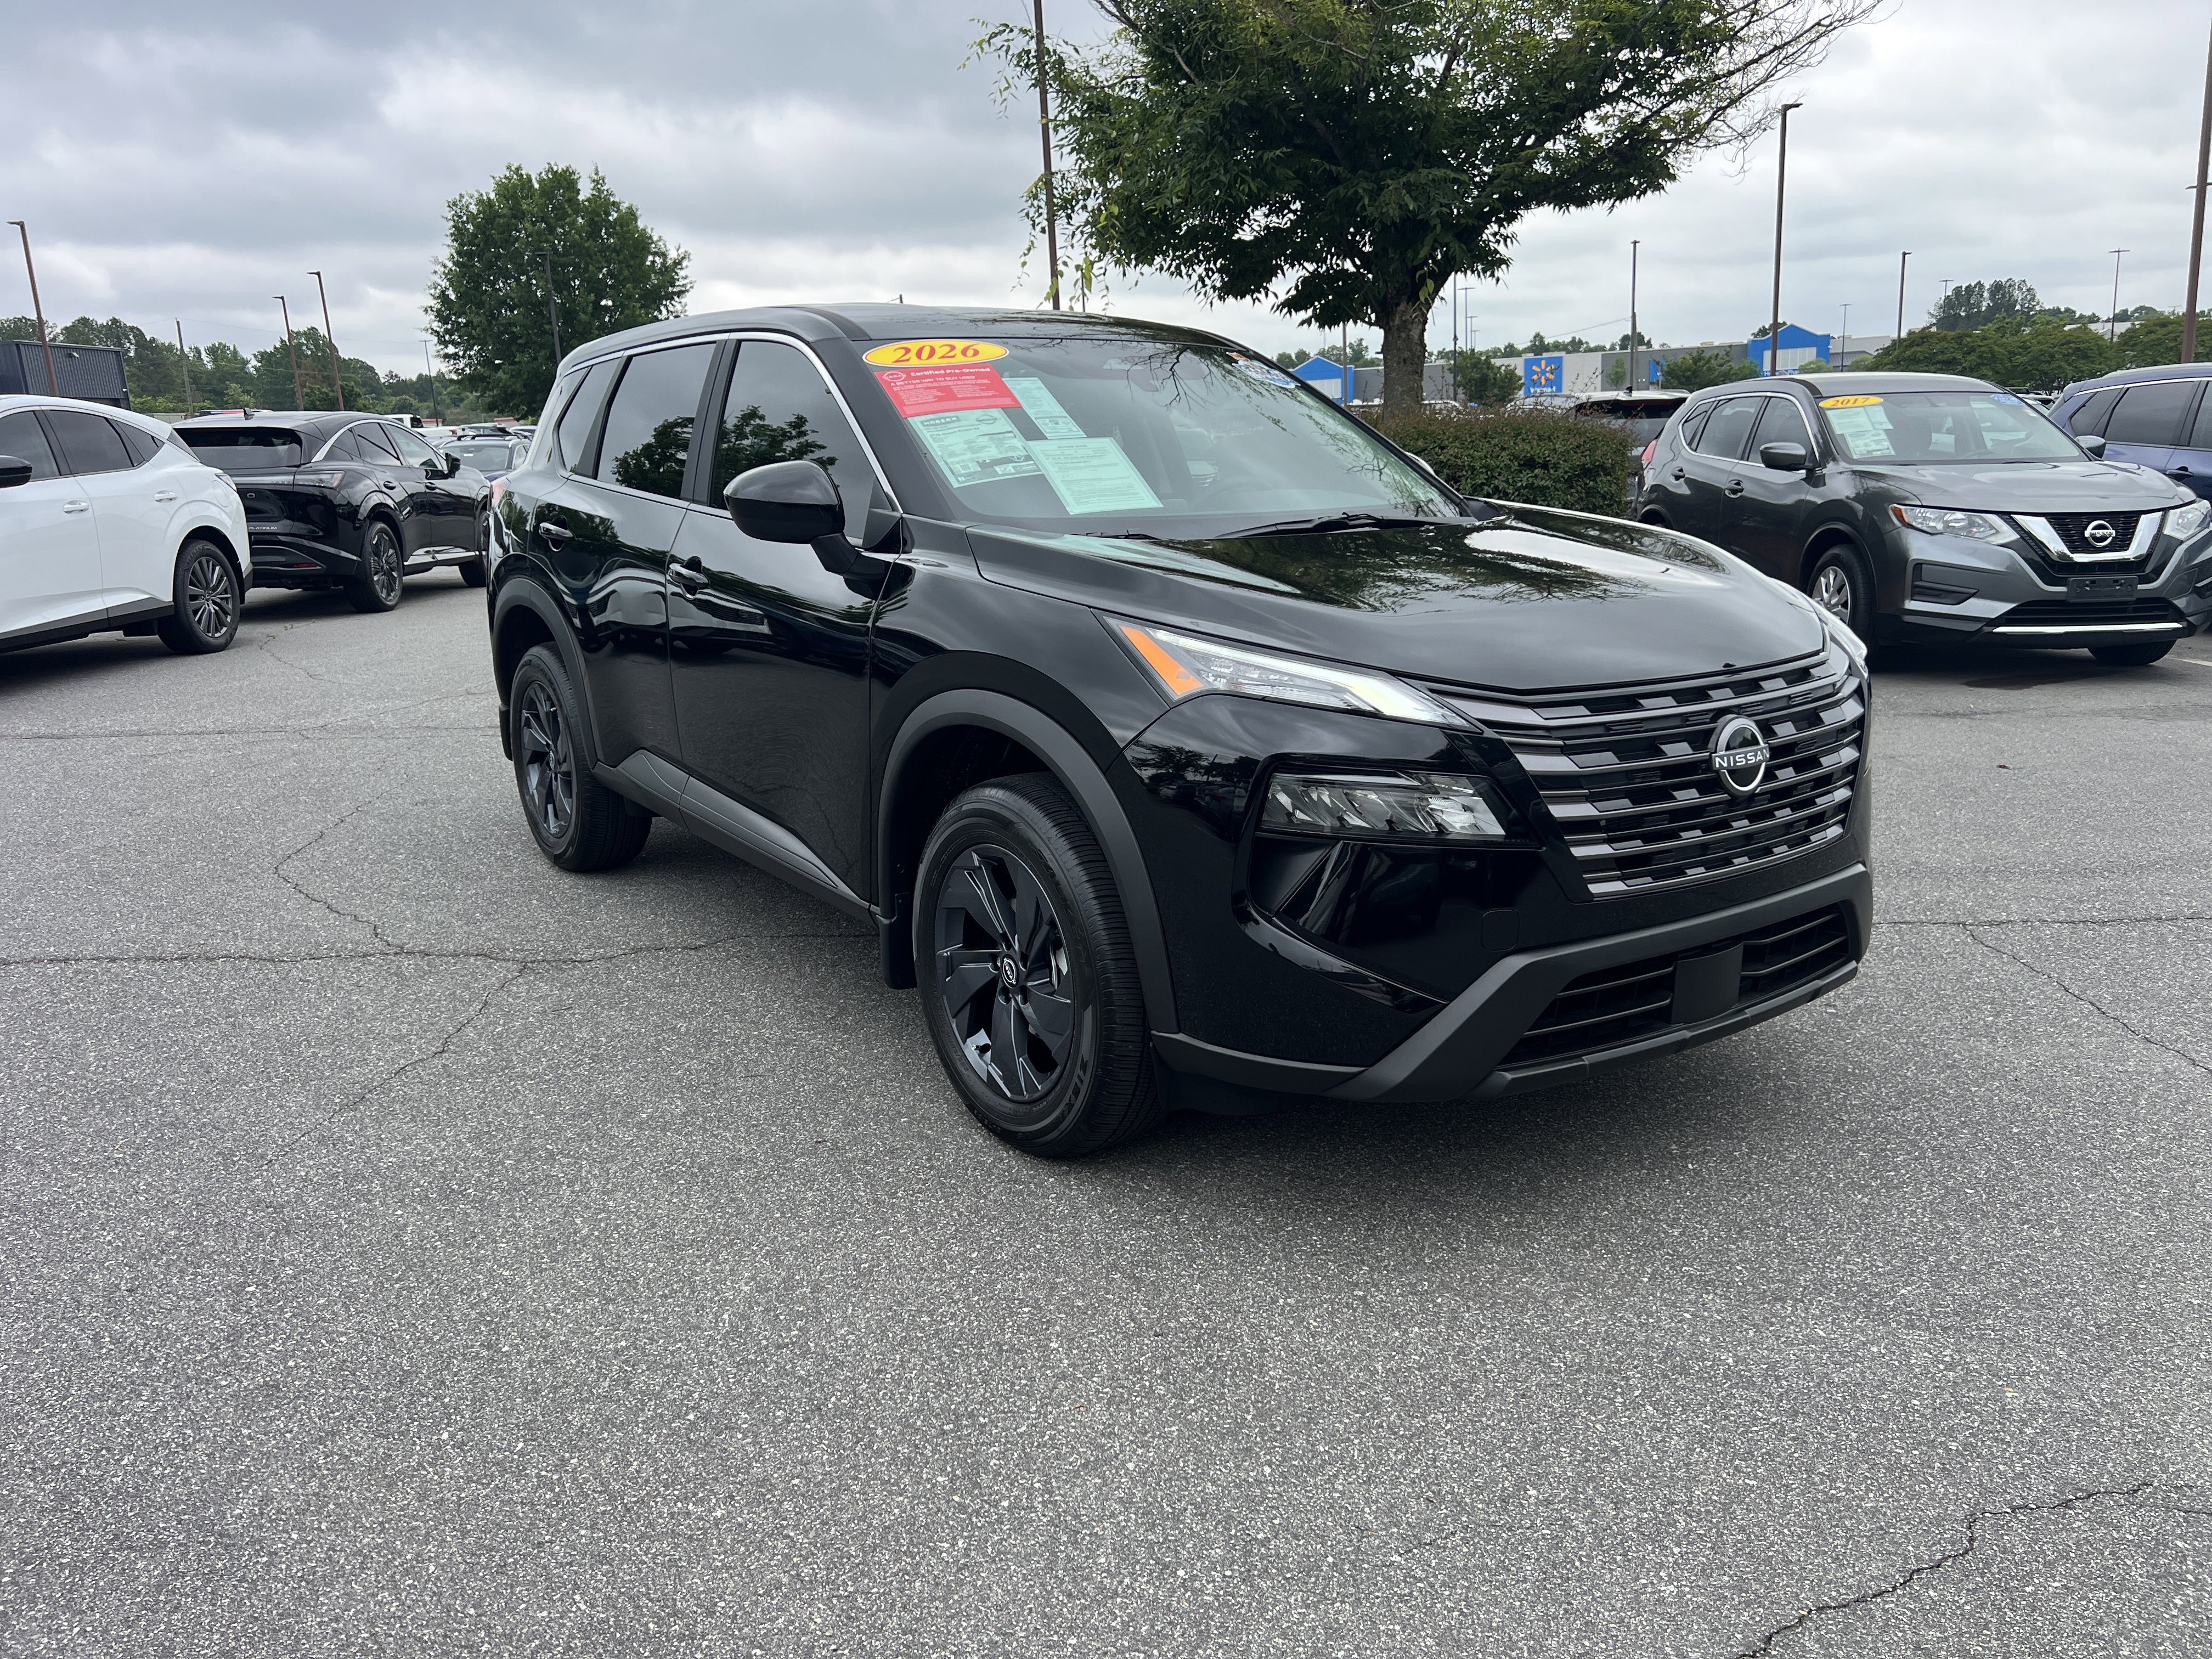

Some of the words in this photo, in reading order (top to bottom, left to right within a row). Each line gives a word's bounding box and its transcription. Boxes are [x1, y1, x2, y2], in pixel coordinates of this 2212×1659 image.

[892, 343, 980, 363] 2026
[1830, 397, 1870, 407] 2017
[923, 417, 957, 425] MODERN
[1716, 749, 1770, 768] NISSAN
